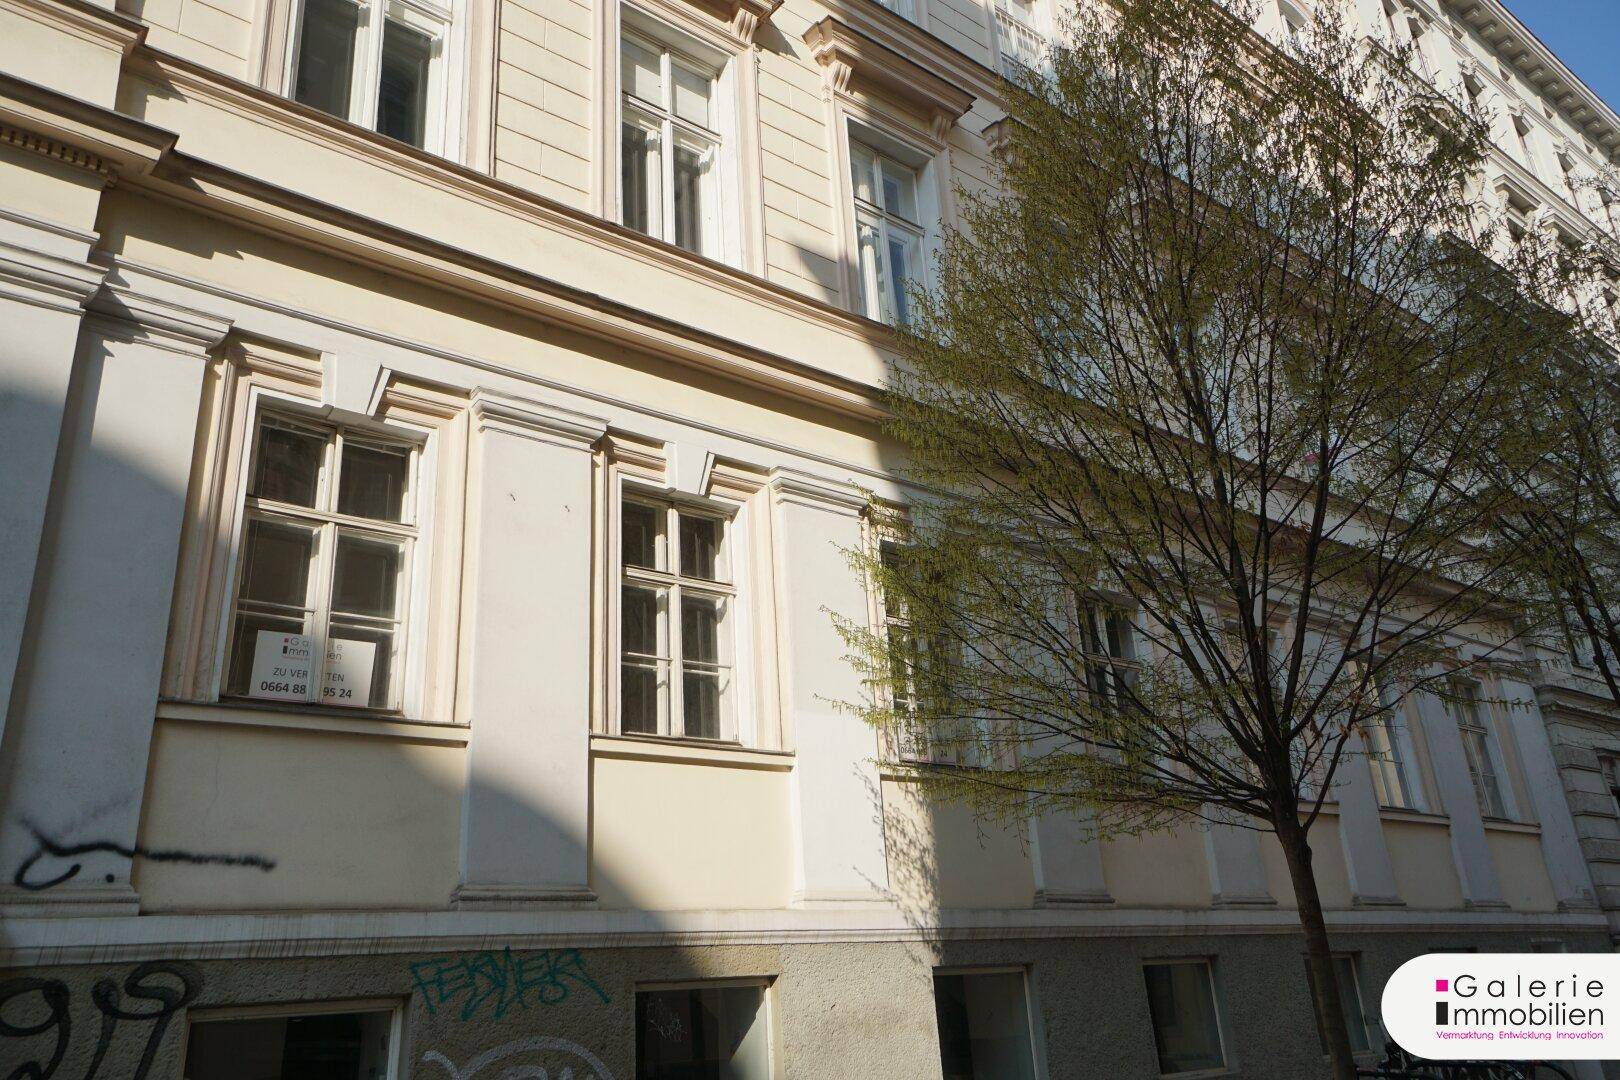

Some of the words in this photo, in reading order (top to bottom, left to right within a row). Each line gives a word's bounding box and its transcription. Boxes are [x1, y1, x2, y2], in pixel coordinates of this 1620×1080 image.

[273, 667, 287, 677] ZU
[290, 669, 345, 682] VERTEN
[260, 681, 289, 693] 0664
[339, 688, 352, 699] 24
